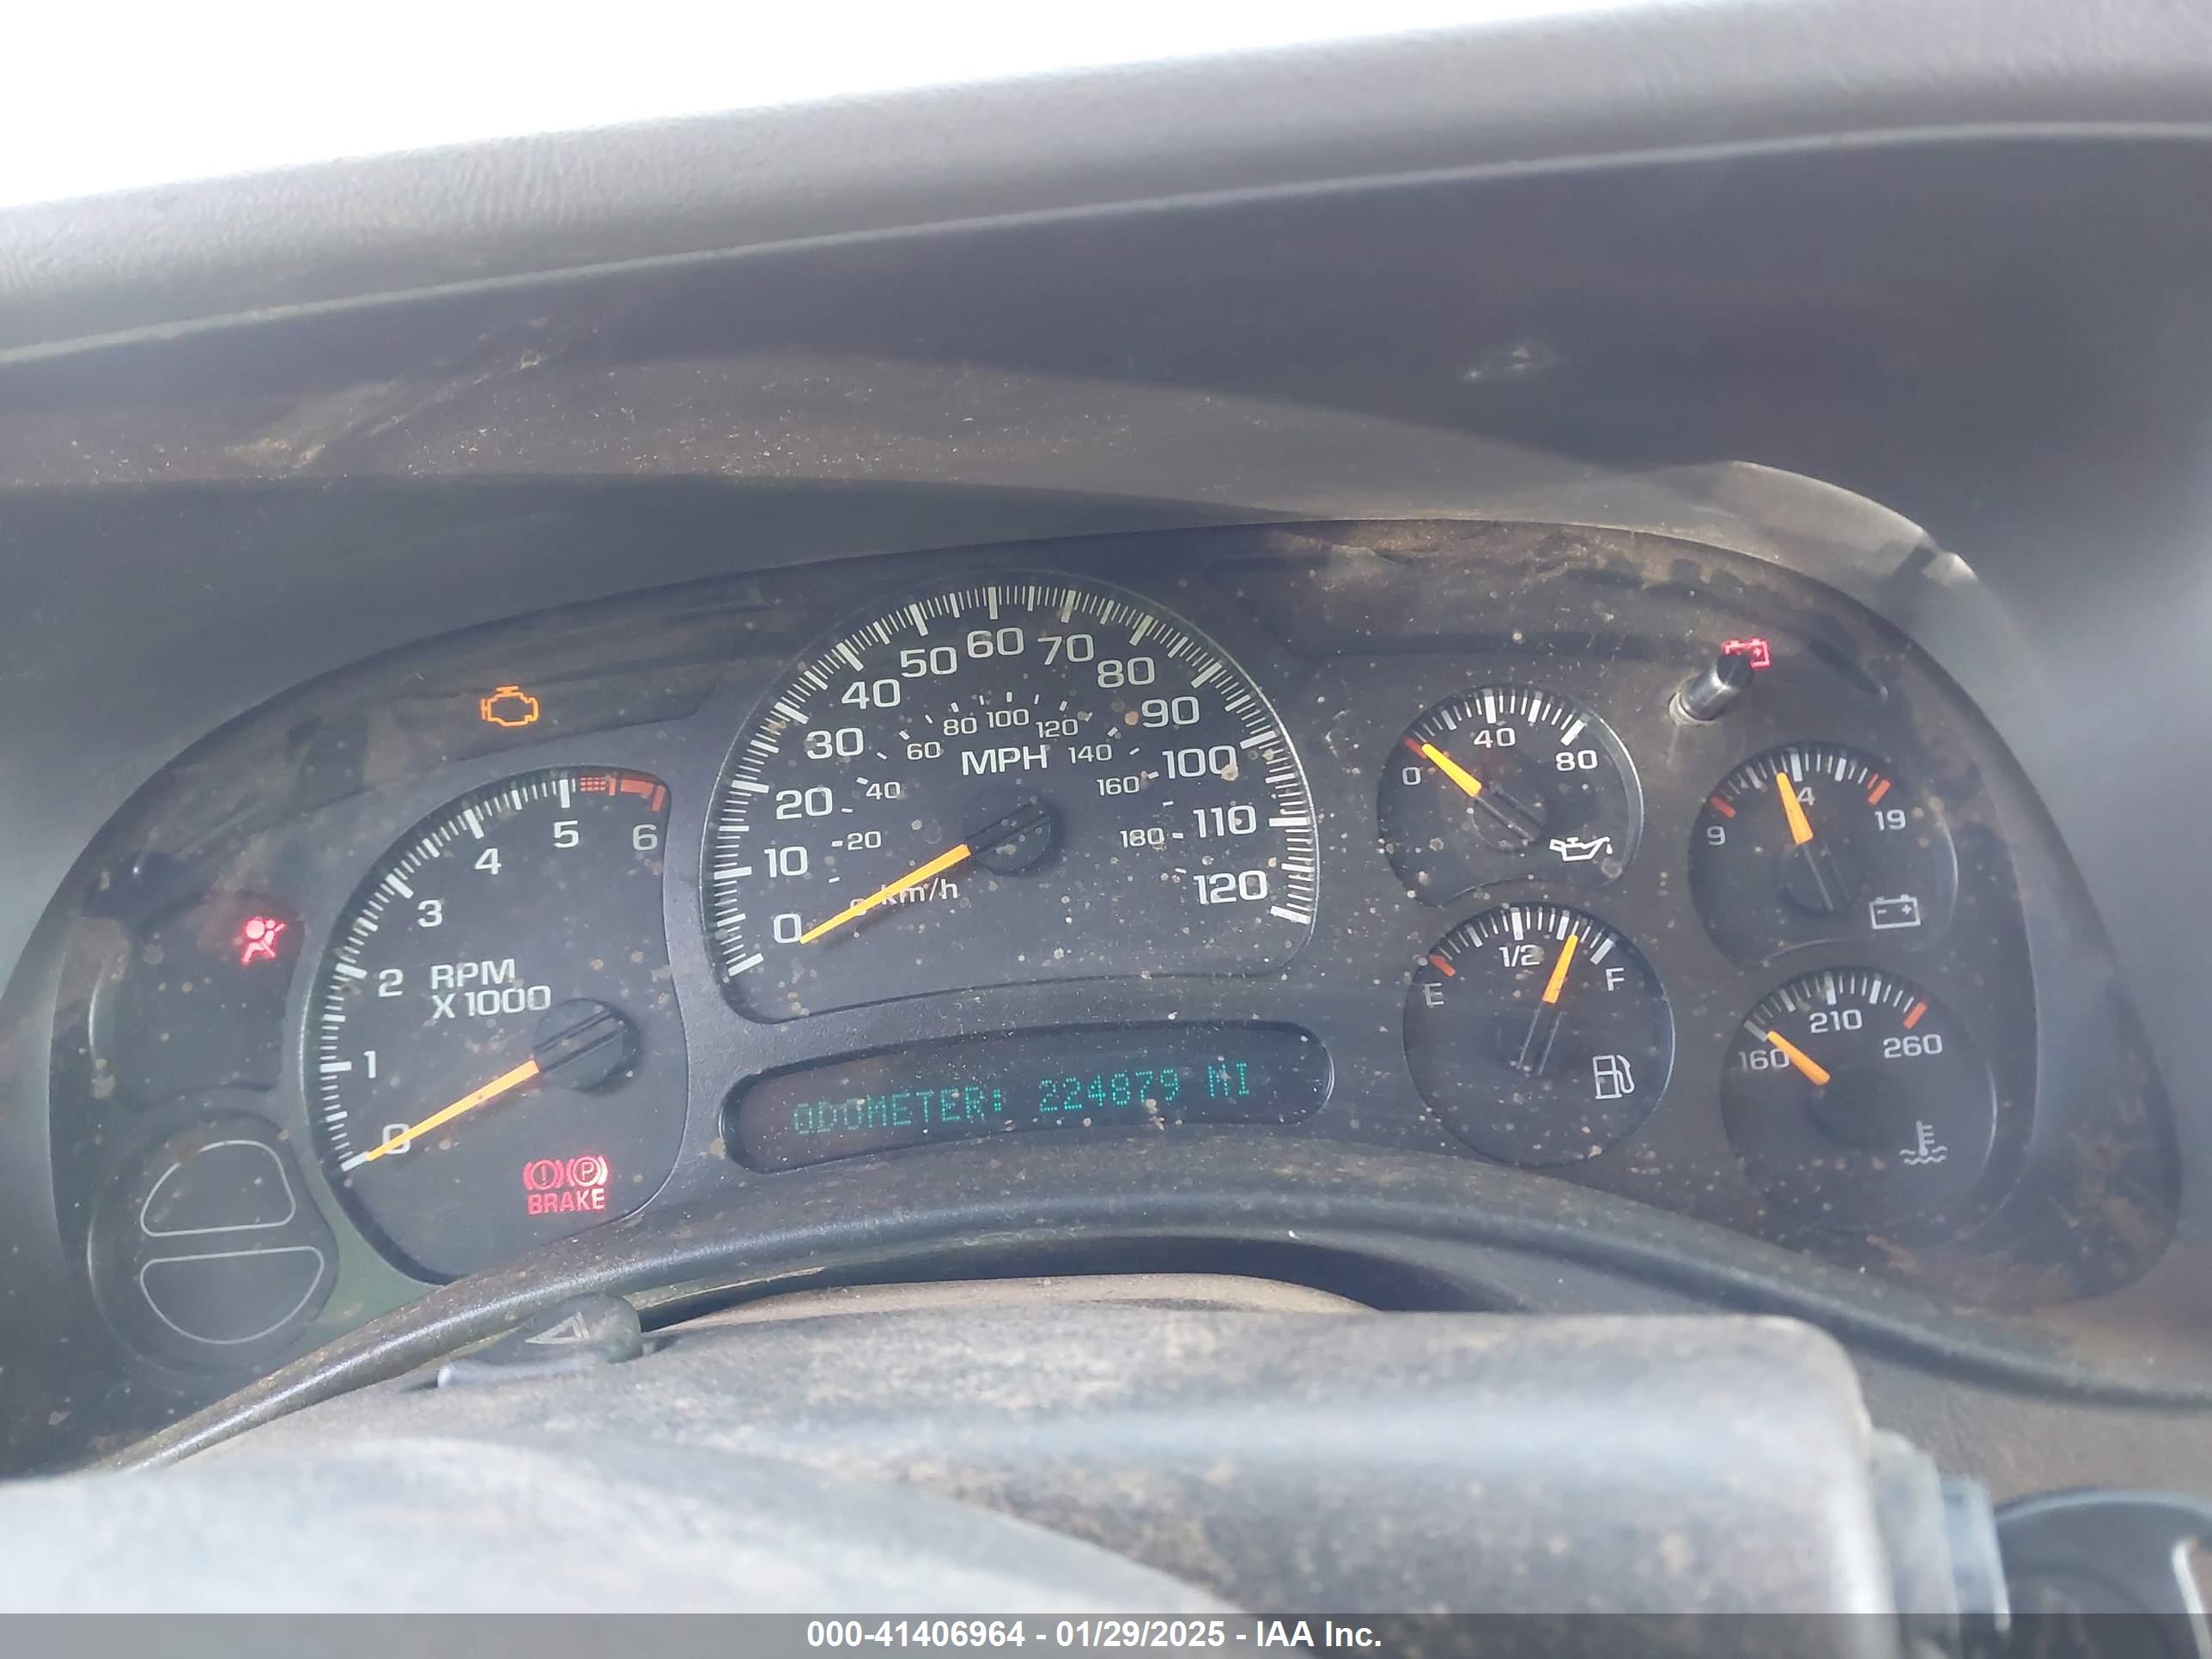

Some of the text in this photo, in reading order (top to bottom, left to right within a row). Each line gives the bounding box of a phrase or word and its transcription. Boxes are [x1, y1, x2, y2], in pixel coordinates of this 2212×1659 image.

[967, 627, 1026, 659] 60
[1036, 633, 1095, 665] 70
[899, 647, 957, 678] 50
[1097, 656, 1156, 689] 80
[841, 678, 901, 710] 40
[986, 708, 1030, 729] 100
[1140, 696, 1200, 728] 90
[943, 715, 978, 737] 80
[1037, 718, 1079, 738] 120
[1473, 726, 1516, 749] 40
[807, 728, 864, 760] 30
[907, 740, 941, 760] 60
[1068, 744, 1113, 764] 140
[961, 747, 1048, 776] MPH
[1162, 744, 1237, 780] 100
[1555, 750, 1599, 771] 80
[1097, 776, 1140, 797] 160
[1401, 767, 1422, 786] 0
[775, 788, 833, 820] 20
[866, 781, 902, 800] 40
[1192, 805, 1257, 838] 110
[1875, 809, 1906, 831] 19
[553, 820, 580, 848] 5
[632, 823, 658, 850] 6
[847, 830, 883, 850] 20
[1120, 827, 1165, 848] 180
[1706, 825, 1726, 847] 9
[474, 848, 502, 875] 4
[764, 846, 809, 878] 10
[1193, 870, 1269, 906] 120
[418, 900, 443, 928] 3
[774, 913, 802, 944] 0
[1499, 945, 1541, 968] 1/2
[378, 969, 404, 998] 2
[431, 958, 516, 990] RPM
[1606, 967, 1625, 992] F
[432, 984, 552, 1020] X 1000
[1425, 982, 1444, 1006] E
[1808, 1009, 1863, 1034] 210
[1738, 1048, 1790, 1072] 160
[1882, 1034, 1943, 1059] 260
[363, 1050, 377, 1079] 1
[793, 1062, 1250, 1135] ODOMETER: 224879 MI
[382, 1123, 411, 1154] 0
[527, 1188, 605, 1215] BRAKE
